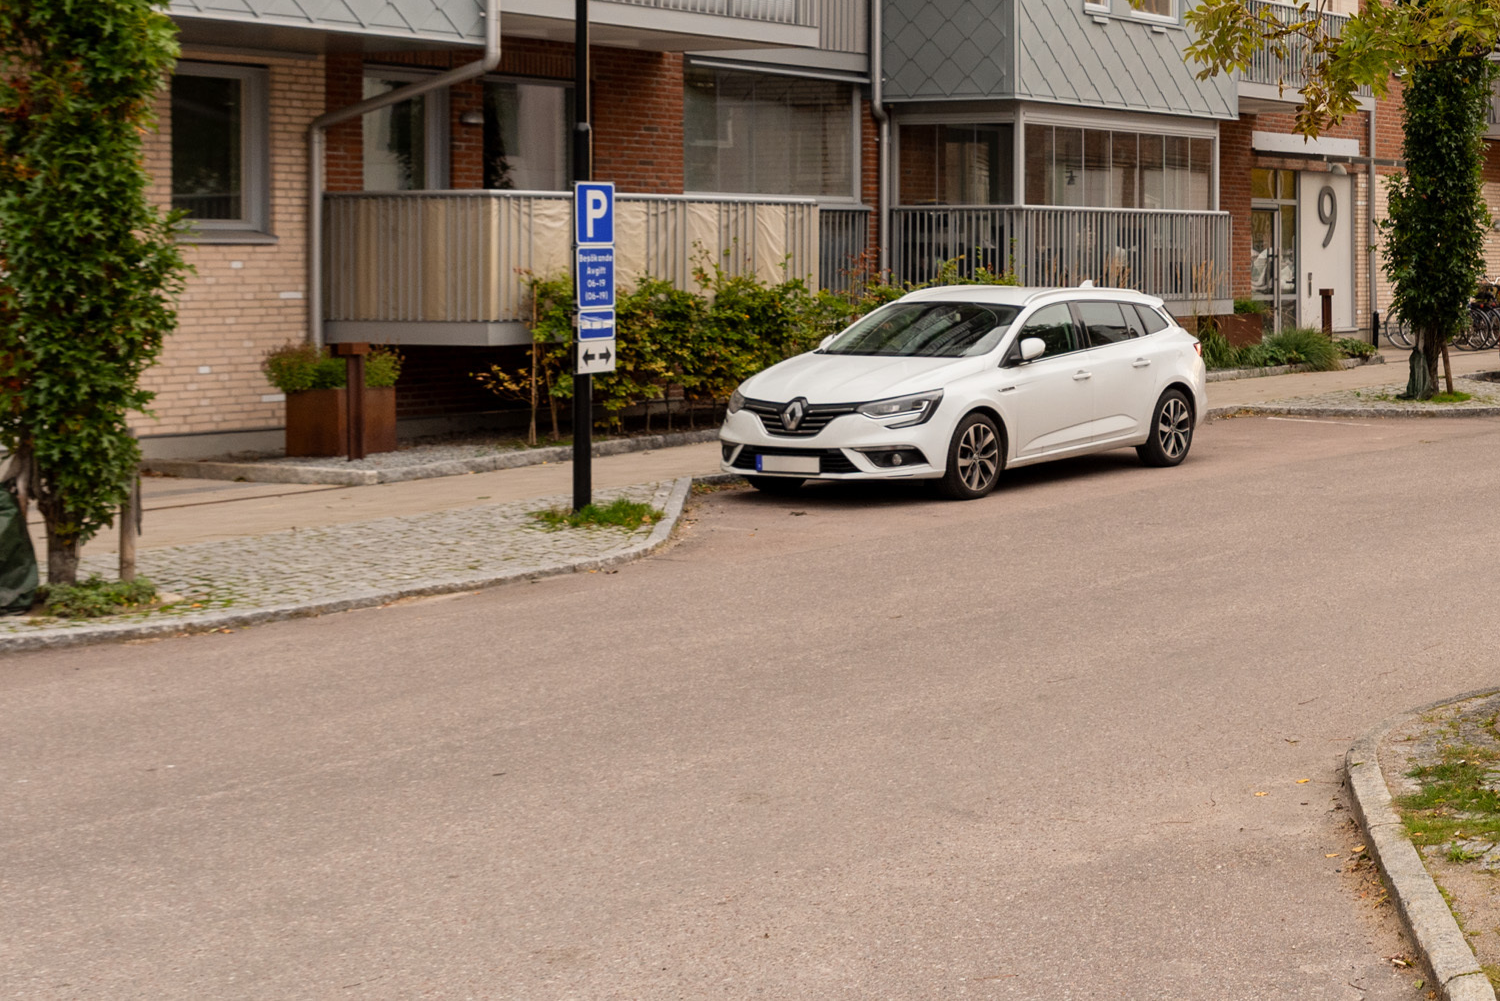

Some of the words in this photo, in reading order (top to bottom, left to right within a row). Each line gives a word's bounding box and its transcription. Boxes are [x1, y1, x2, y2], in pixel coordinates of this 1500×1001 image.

[586, 189, 608, 238] P
[1318, 186, 1338, 249] 9
[587, 266, 606, 277] Avgift
